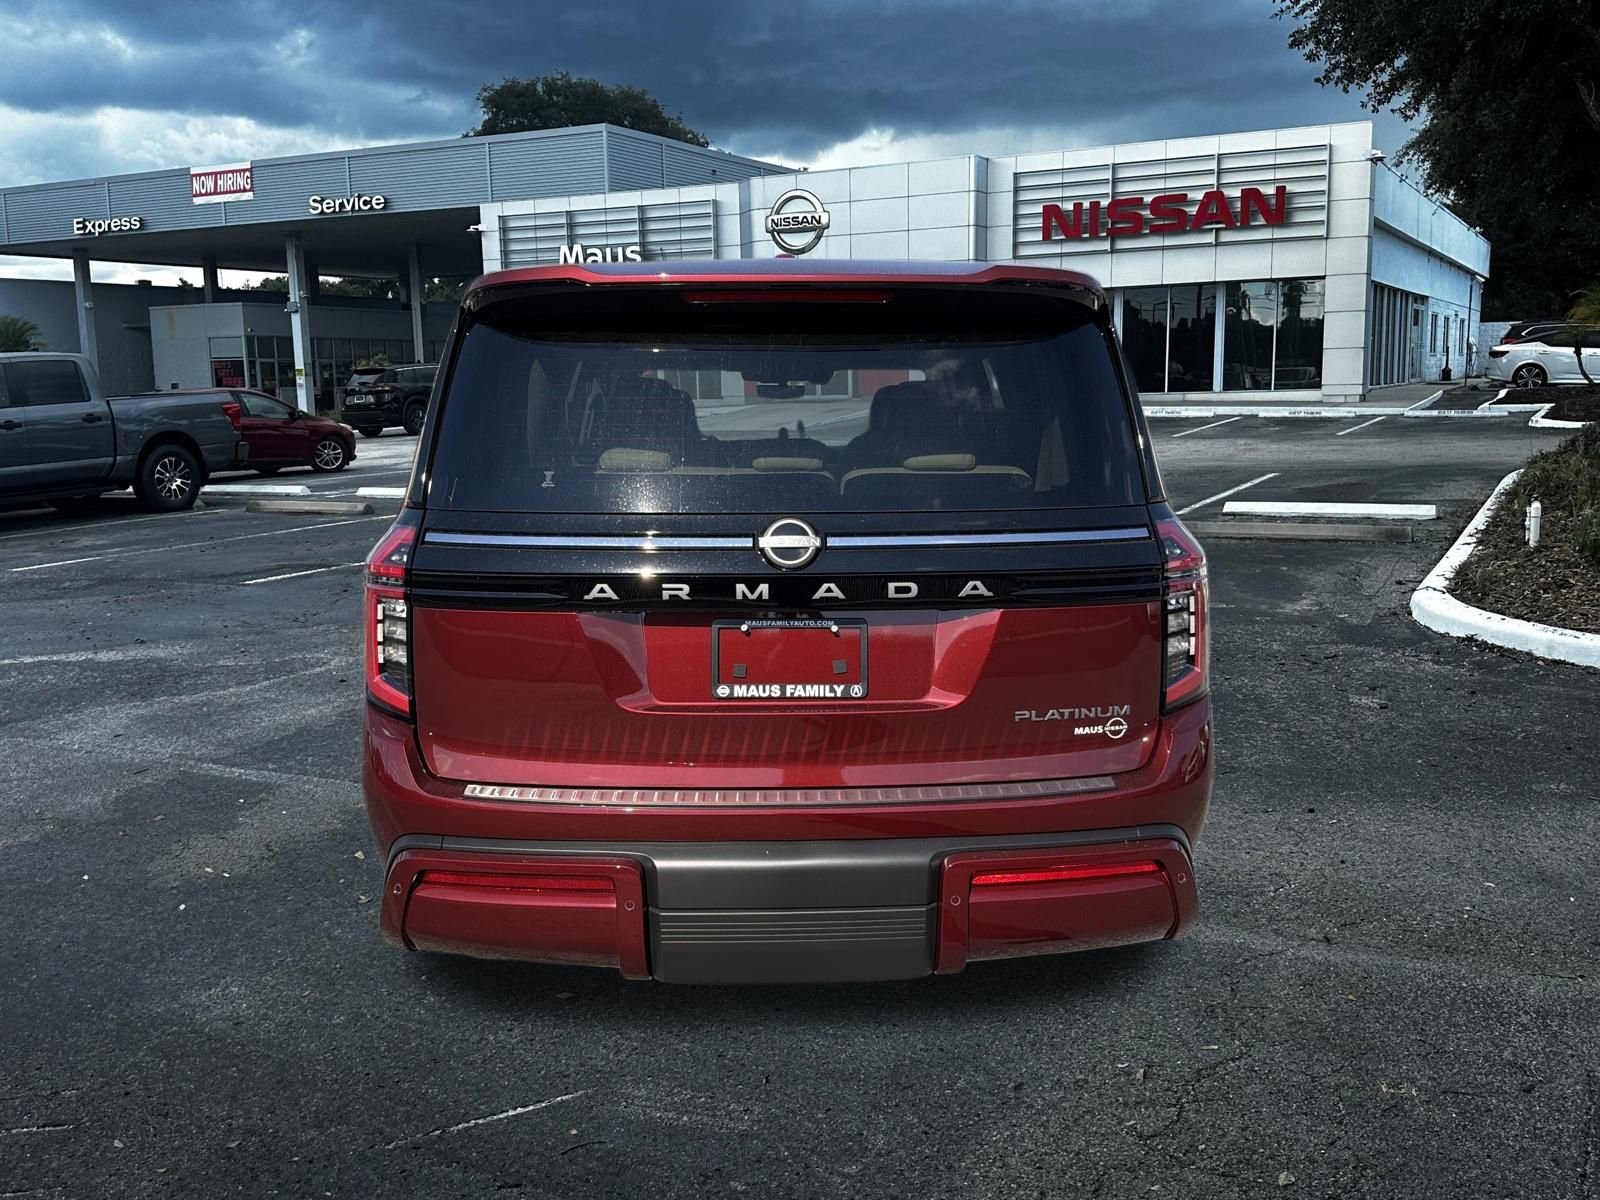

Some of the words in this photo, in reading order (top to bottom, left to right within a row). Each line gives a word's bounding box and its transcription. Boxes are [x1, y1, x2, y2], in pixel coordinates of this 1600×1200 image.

[192, 174, 216, 195] NOW
[217, 171, 251, 192] HIRING
[308, 193, 386, 215] Service
[1041, 185, 1287, 241] NISSAN
[73, 216, 141, 237] Express
[769, 214, 823, 229] NISSAN
[559, 243, 642, 265] Maus
[583, 580, 994, 600] ARMADA
[733, 685, 781, 697] MAUS
[786, 685, 845, 697] FAMILY
[1014, 704, 1131, 722] PLATINUM
[1074, 725, 1103, 735] MAUS
